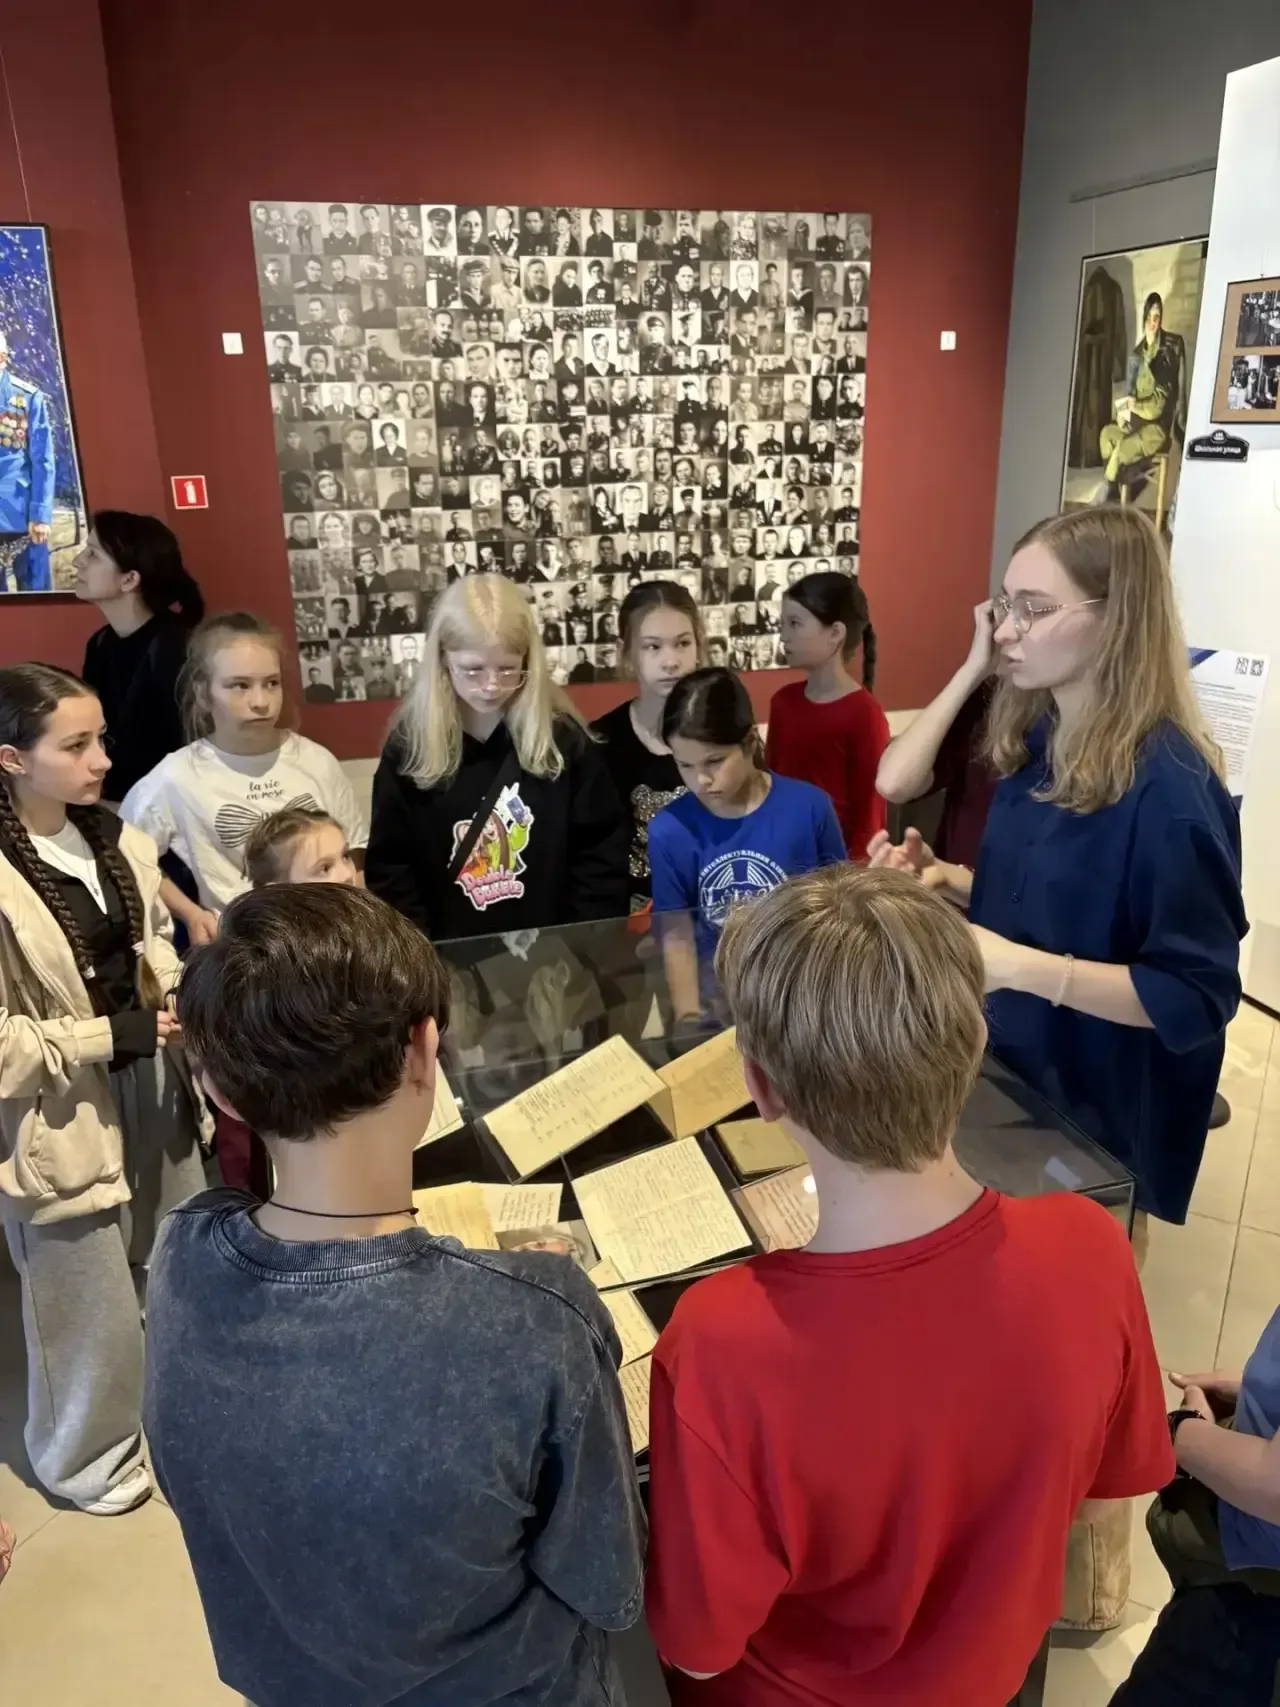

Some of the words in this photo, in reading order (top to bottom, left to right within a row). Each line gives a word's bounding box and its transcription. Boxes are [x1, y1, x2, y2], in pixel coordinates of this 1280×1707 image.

[249, 781, 261, 791] la
[264, 779, 281, 789] vie
[262, 789, 284, 799] rose
